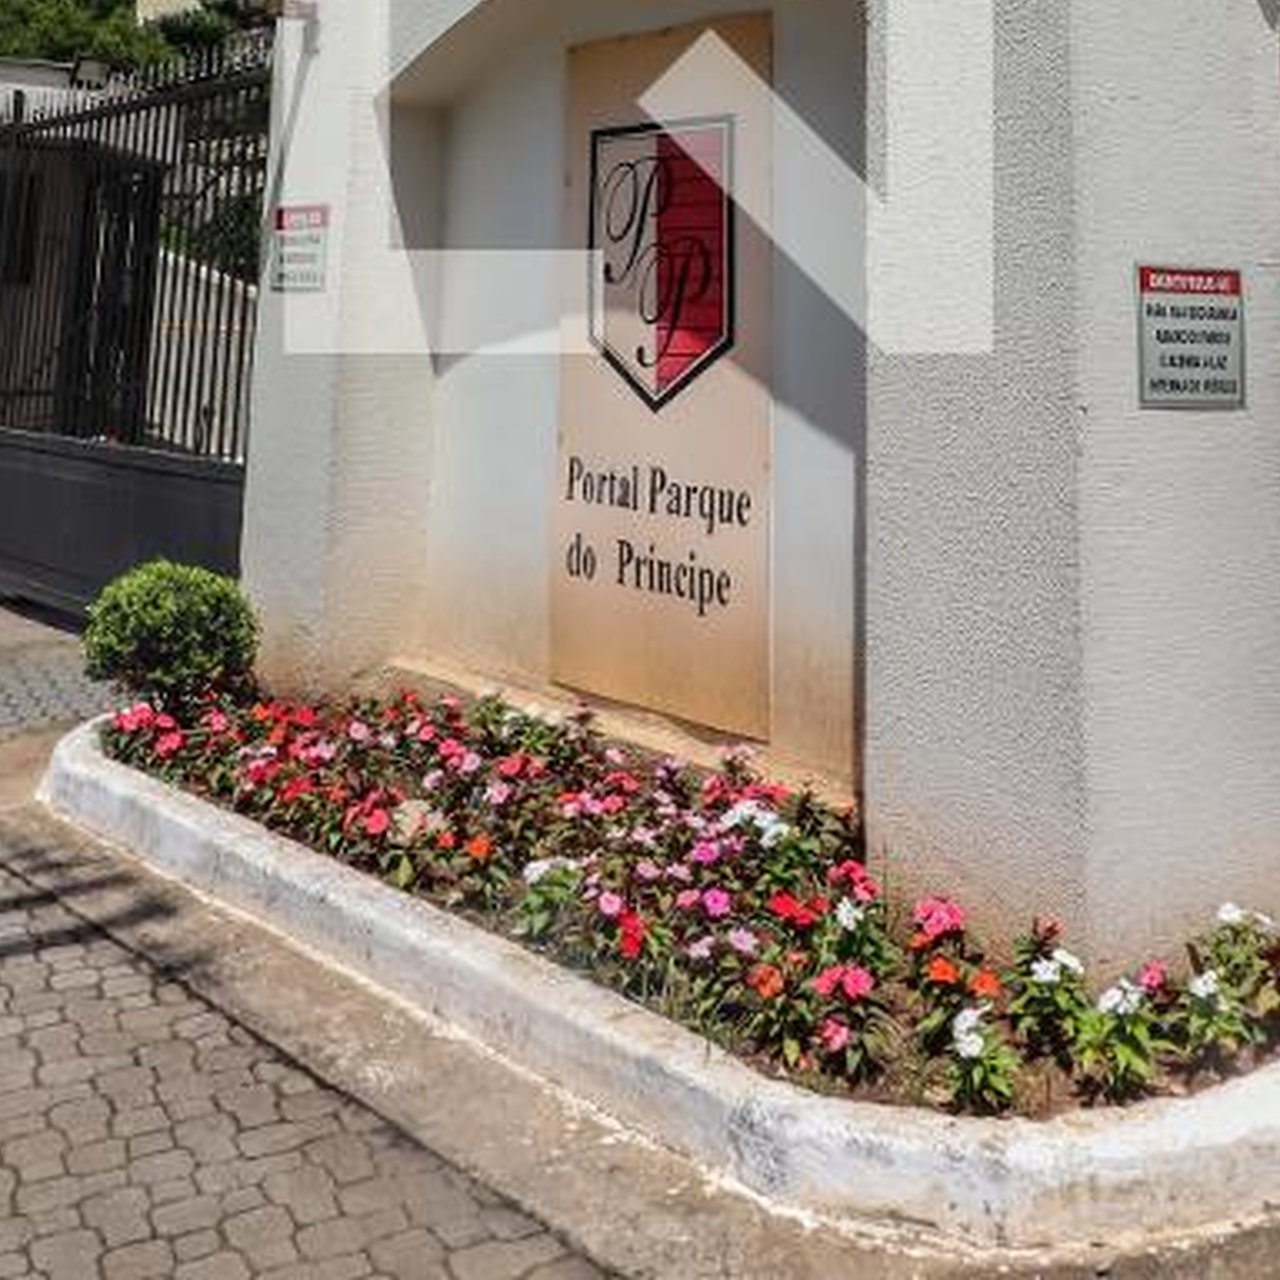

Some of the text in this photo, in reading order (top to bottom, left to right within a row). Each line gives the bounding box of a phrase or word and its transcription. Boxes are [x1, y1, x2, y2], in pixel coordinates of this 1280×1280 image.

[566, 456, 751, 534] Portal Parque
[566, 533, 731, 616] do Principe
